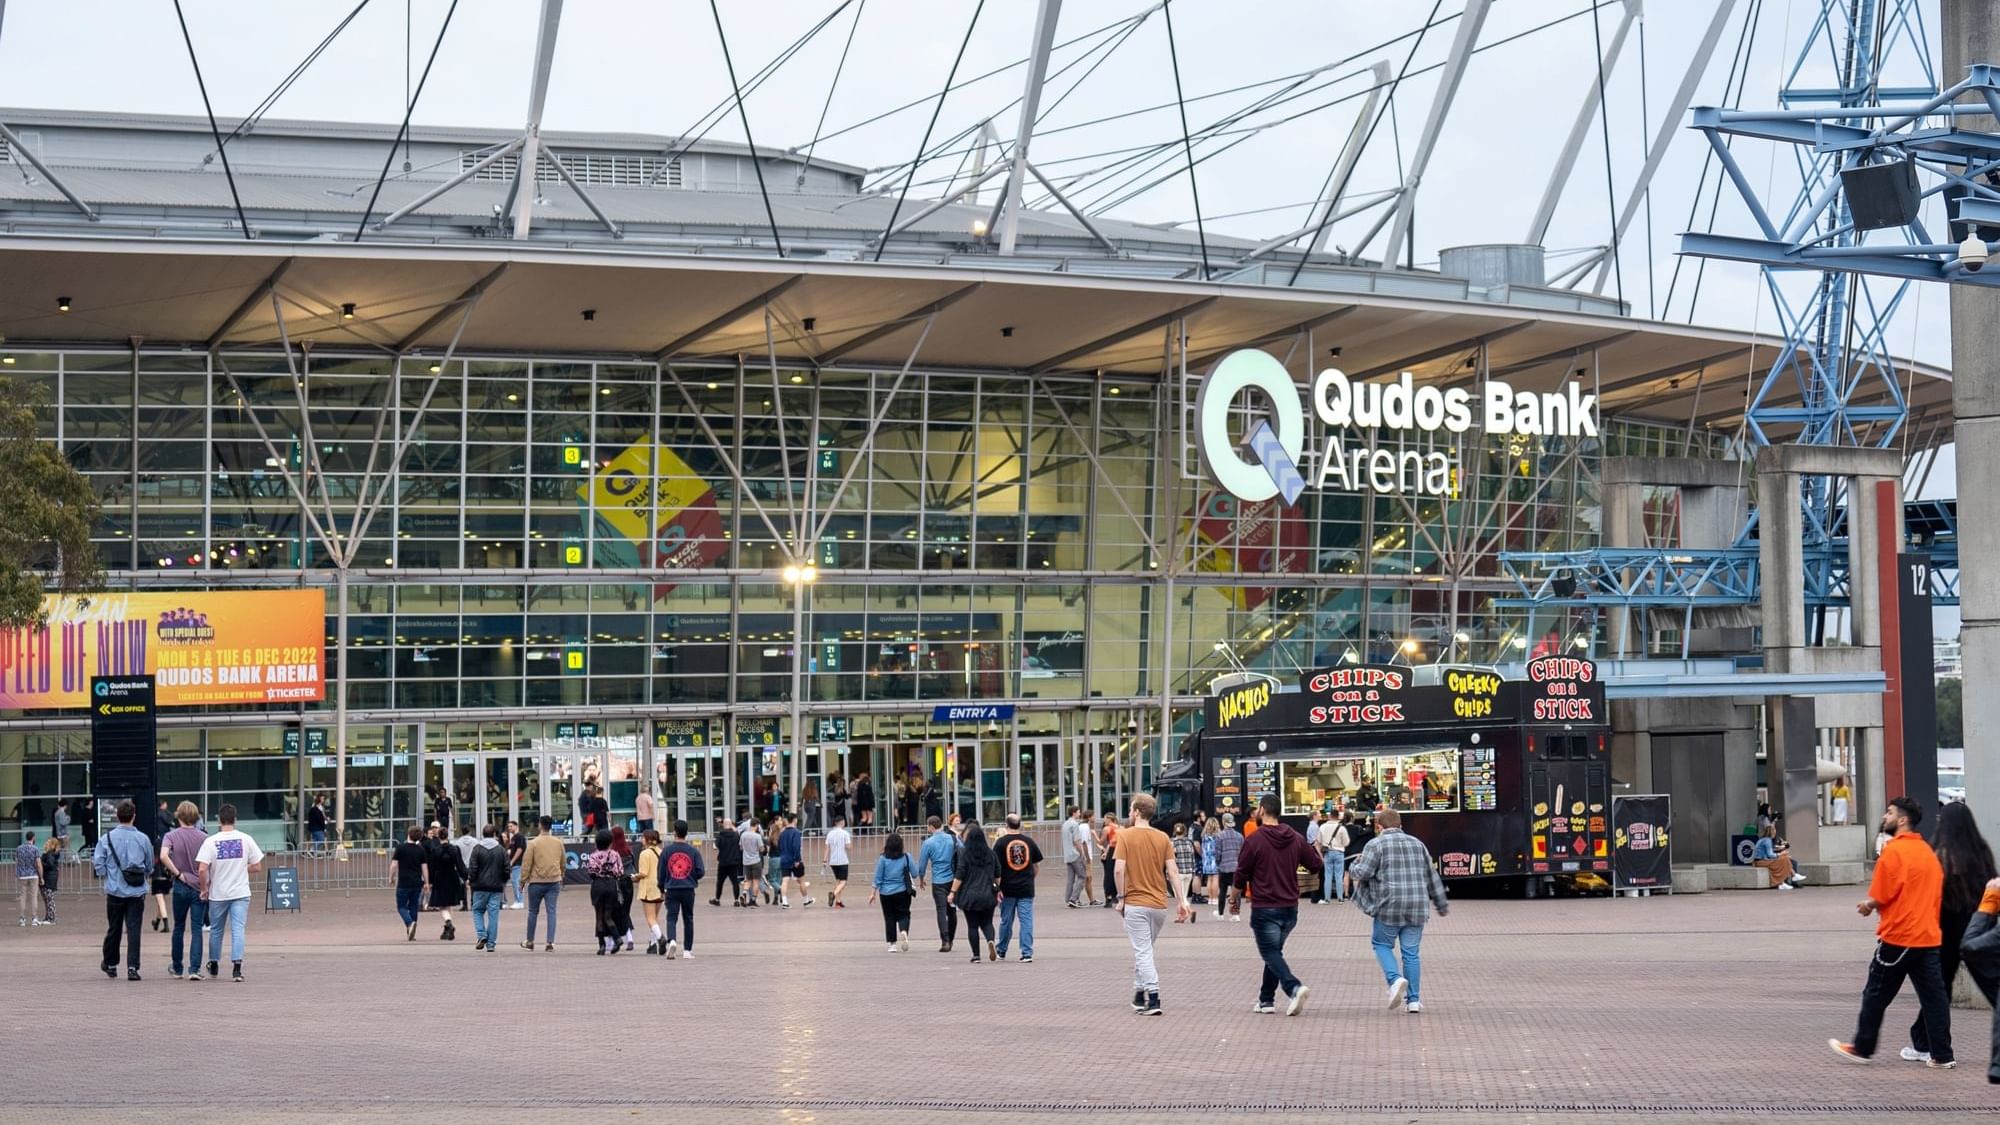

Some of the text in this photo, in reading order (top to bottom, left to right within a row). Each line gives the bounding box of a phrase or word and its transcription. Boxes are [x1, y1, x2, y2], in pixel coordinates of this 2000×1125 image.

[1314, 368, 1598, 437] Qudos Bank
[1316, 435, 1454, 496] Arena
[1911, 564, 1926, 596] 12
[62, 620, 87, 693] OF
[97, 619, 147, 676] NOW
[157, 647, 317, 667] MON 5 & TUE 6 DEC 2022
[156, 664, 318, 686] QUDOS BANK ARENA
[1309, 668, 1403, 692] CHIPS
[1530, 658, 1593, 683] CHIPS
[109, 681, 131, 689] Qudos
[275, 688, 316, 698] TICKETEK
[1448, 672, 1501, 696] CHEEKY
[1547, 682, 1578, 695] on a
[1219, 682, 1269, 728] NACHOS
[1332, 690, 1380, 702] on a
[949, 707, 997, 719] ENTRY A
[1309, 704, 1405, 724] STICK
[1534, 698, 1593, 719] STICK
[657, 720, 703, 728] WHEELCHAIR
[736, 719, 774, 727] HEELCHAIR
